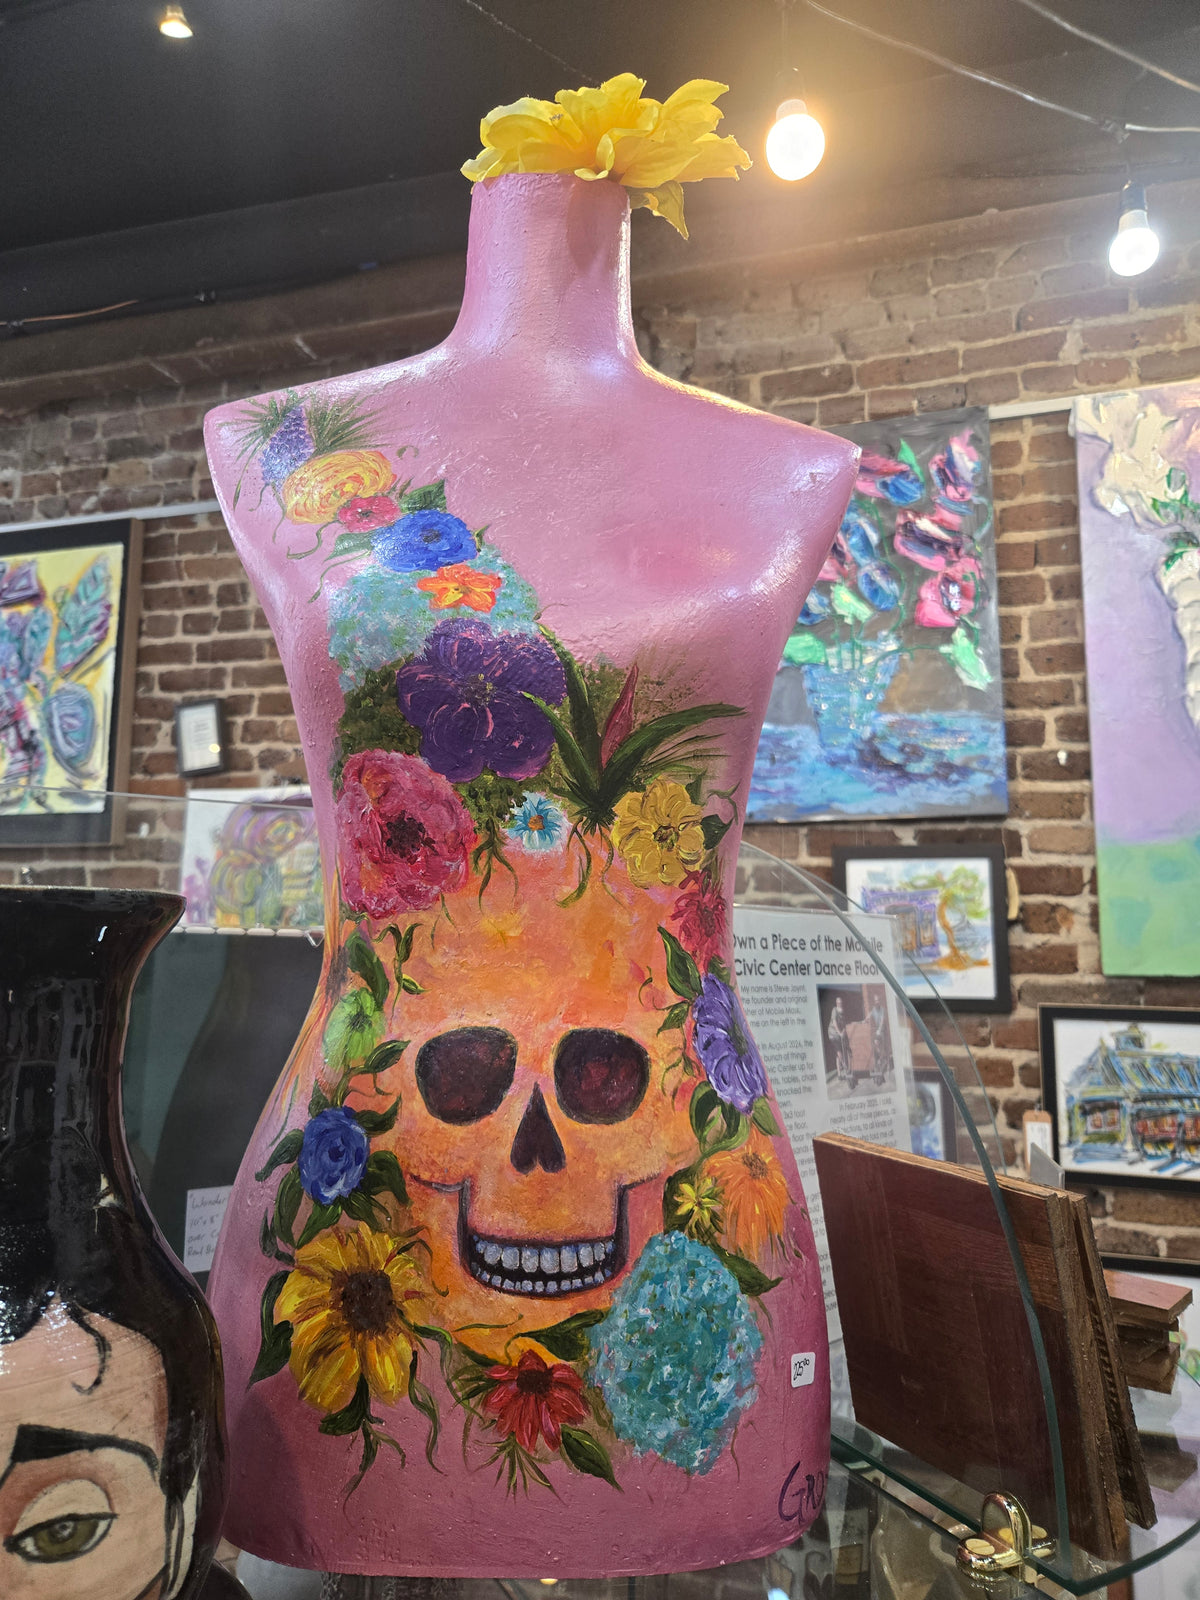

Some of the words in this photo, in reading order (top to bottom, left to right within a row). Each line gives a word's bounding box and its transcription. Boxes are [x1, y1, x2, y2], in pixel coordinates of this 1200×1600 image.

[760, 937, 768, 950] a
[771, 934, 806, 950] Piece
[810, 934, 821, 951] of
[824, 936, 841, 952] the
[845, 936, 883, 952] Moile
[734, 958, 765, 976] Civic
[770, 958, 811, 976] Center
[814, 960, 851, 976] Dance
[741, 985, 749, 994] My
[768, 1041, 788, 1051] August
